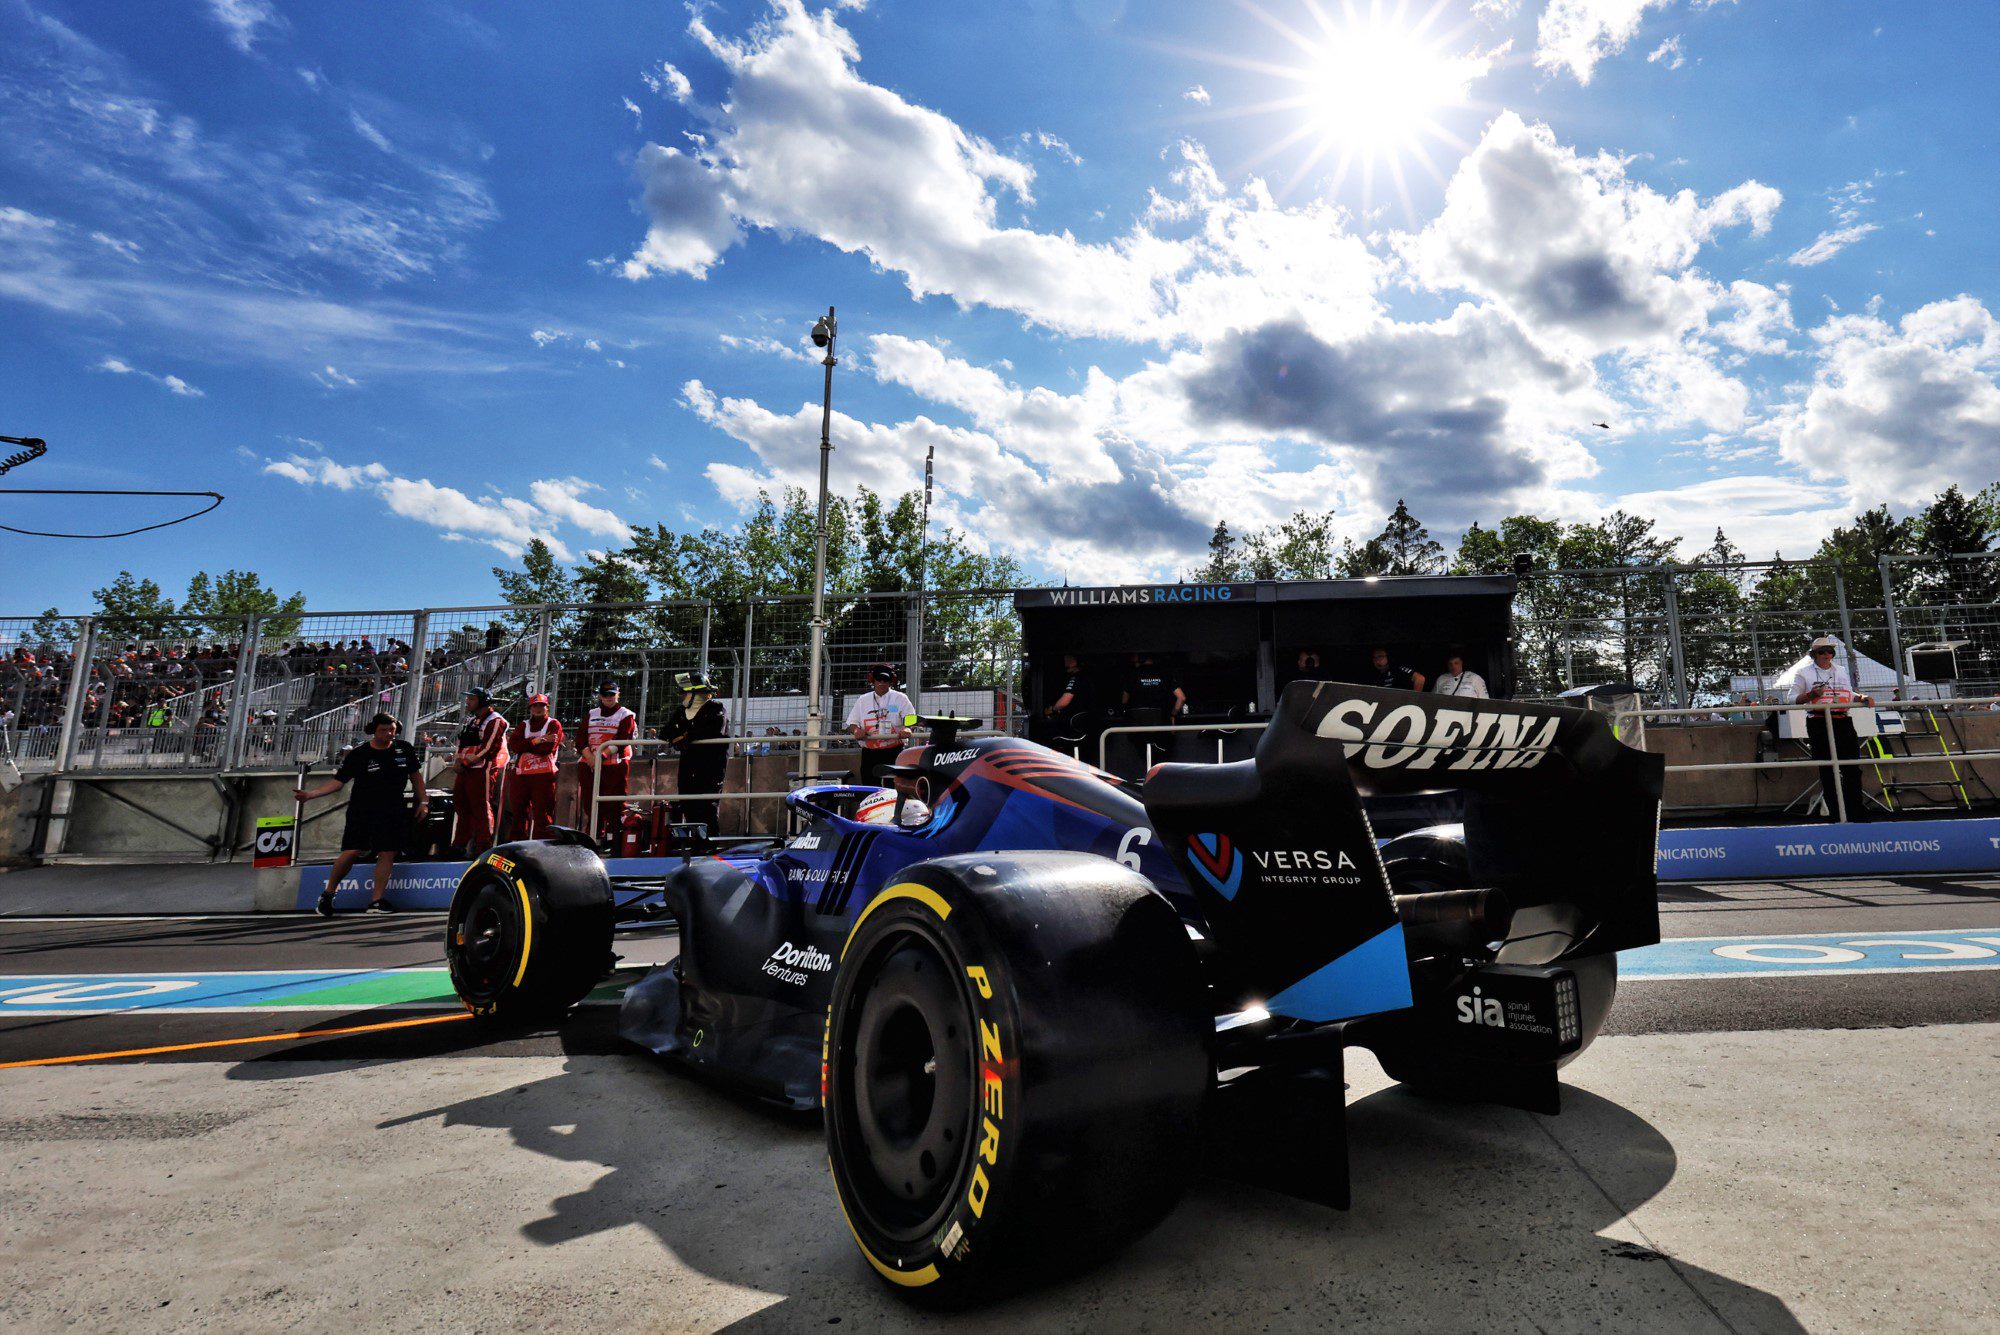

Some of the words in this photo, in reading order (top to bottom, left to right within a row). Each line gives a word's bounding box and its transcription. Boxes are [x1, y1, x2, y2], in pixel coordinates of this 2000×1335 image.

[1050, 588, 1150, 605] WILLIAMS
[1155, 586, 1232, 602] RACING
[1314, 699, 1561, 770] SOFINA
[933, 747, 980, 766] DURACELL
[1116, 827, 1152, 873] 6
[1658, 847, 1726, 860] NICATIONS
[1776, 844, 1816, 857] TATA
[1820, 839, 1940, 855] COMMUNICATIONS
[1252, 850, 1356, 869] VERSA
[323, 879, 359, 890] TTA
[1261, 875, 1317, 883] INTEGRITY
[1322, 876, 1361, 885] GROUP
[771, 941, 831, 972] Dorilton
[761, 958, 808, 986] Ventures
[966, 965, 993, 1000] P
[1457, 986, 1505, 1028] sia
[1507, 1001, 1530, 1011] spinal
[1508, 1011, 1536, 1023] injuries
[1509, 1022, 1553, 1035] association
[968, 1018, 1003, 1219] ZERO
